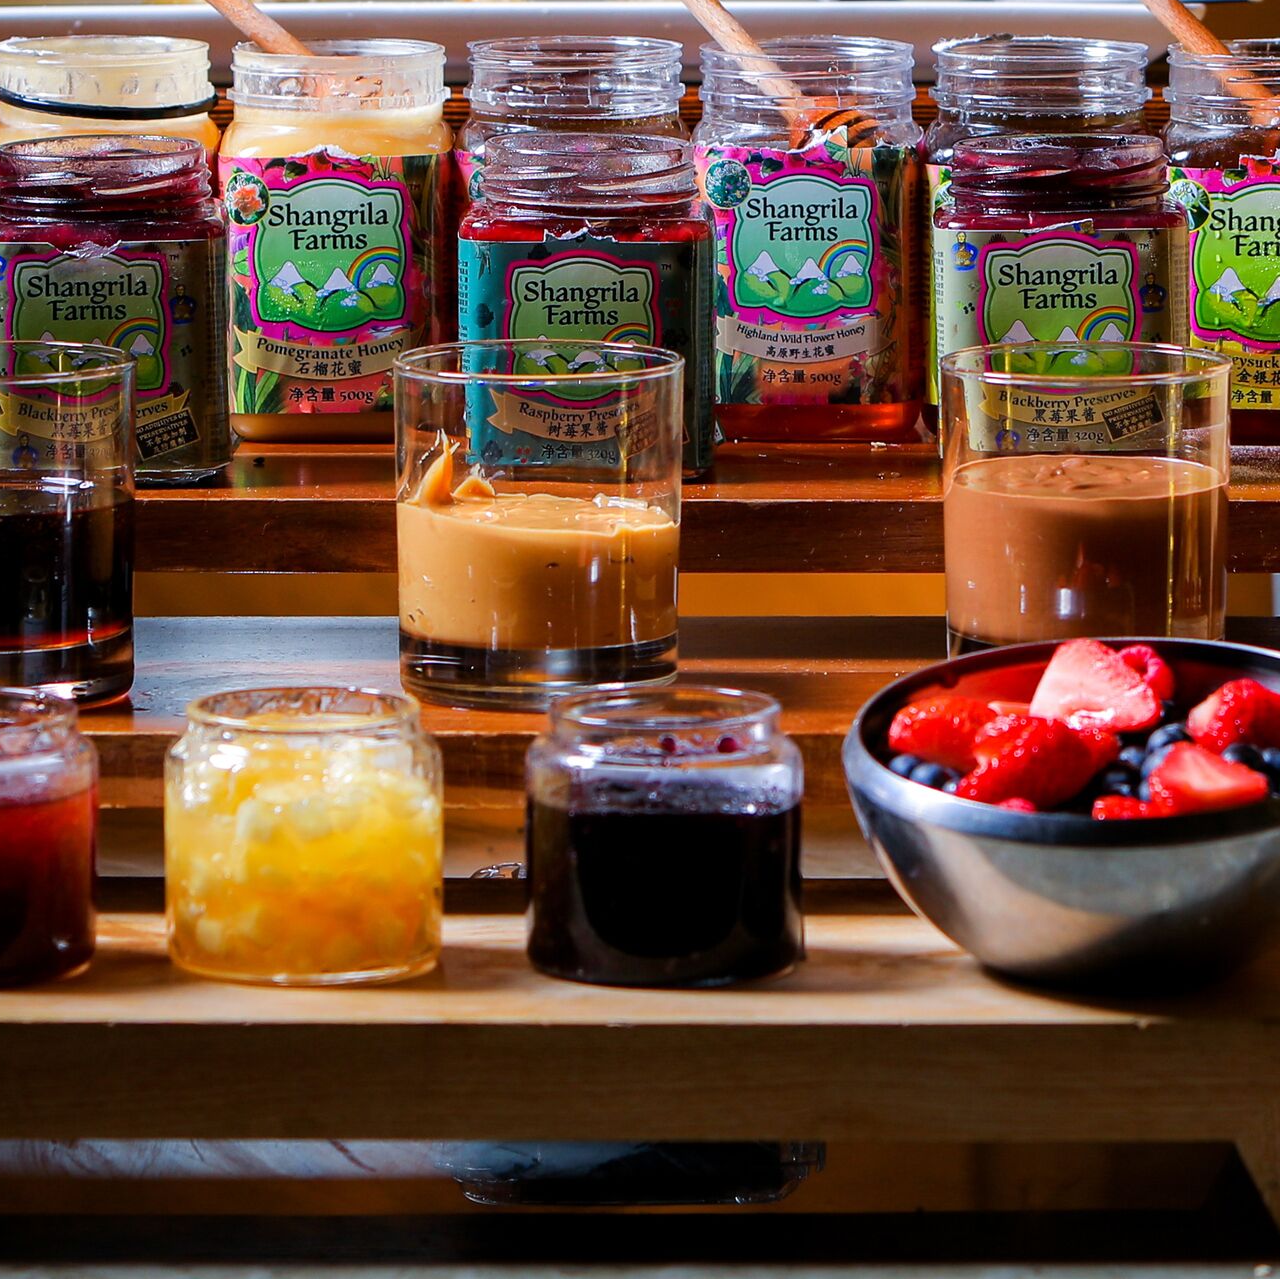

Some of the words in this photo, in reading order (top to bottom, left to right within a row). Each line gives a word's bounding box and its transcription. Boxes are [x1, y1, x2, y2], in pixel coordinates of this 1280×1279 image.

[268, 203, 389, 233] Shangrila
[746, 197, 858, 226] Shangrila
[288, 229, 368, 251] Farms
[765, 220, 838, 242] Farms
[998, 261, 1118, 293] Shangrila
[27, 273, 148, 304] Shangrila
[524, 280, 640, 310] Shangrila
[1017, 288, 1097, 309] Farms
[47, 300, 126, 321] Farms
[542, 304, 619, 326] Farms
[737, 324, 779, 343] Highland
[780, 333, 802, 344] Wild
[804, 333, 835, 344] Flower
[837, 325, 866, 341] Honey
[256, 337, 353, 361] Pomegranate
[358, 337, 404, 357] Honey
[766, 344, 835, 359] 高原野生花蜜
[295, 361, 363, 377] 石榴花蜜
[762, 369, 806, 383] 净含量
[810, 372, 842, 384] 500g
[289, 387, 335, 402] 净含量
[340, 391, 374, 403] 500g
[999, 390, 1071, 410] Blackberry
[1074, 388, 1137, 408] Preserves
[1232, 389, 1273, 404] 净含量
[519, 402, 585, 424] Raspberry
[1032, 407, 1096, 423] 黑莓果酱
[1026, 427, 1070, 442] 净含量
[1073, 431, 1105, 444] 320g
[541, 444, 584, 459] 净含量
[587, 449, 616, 463] 320g
